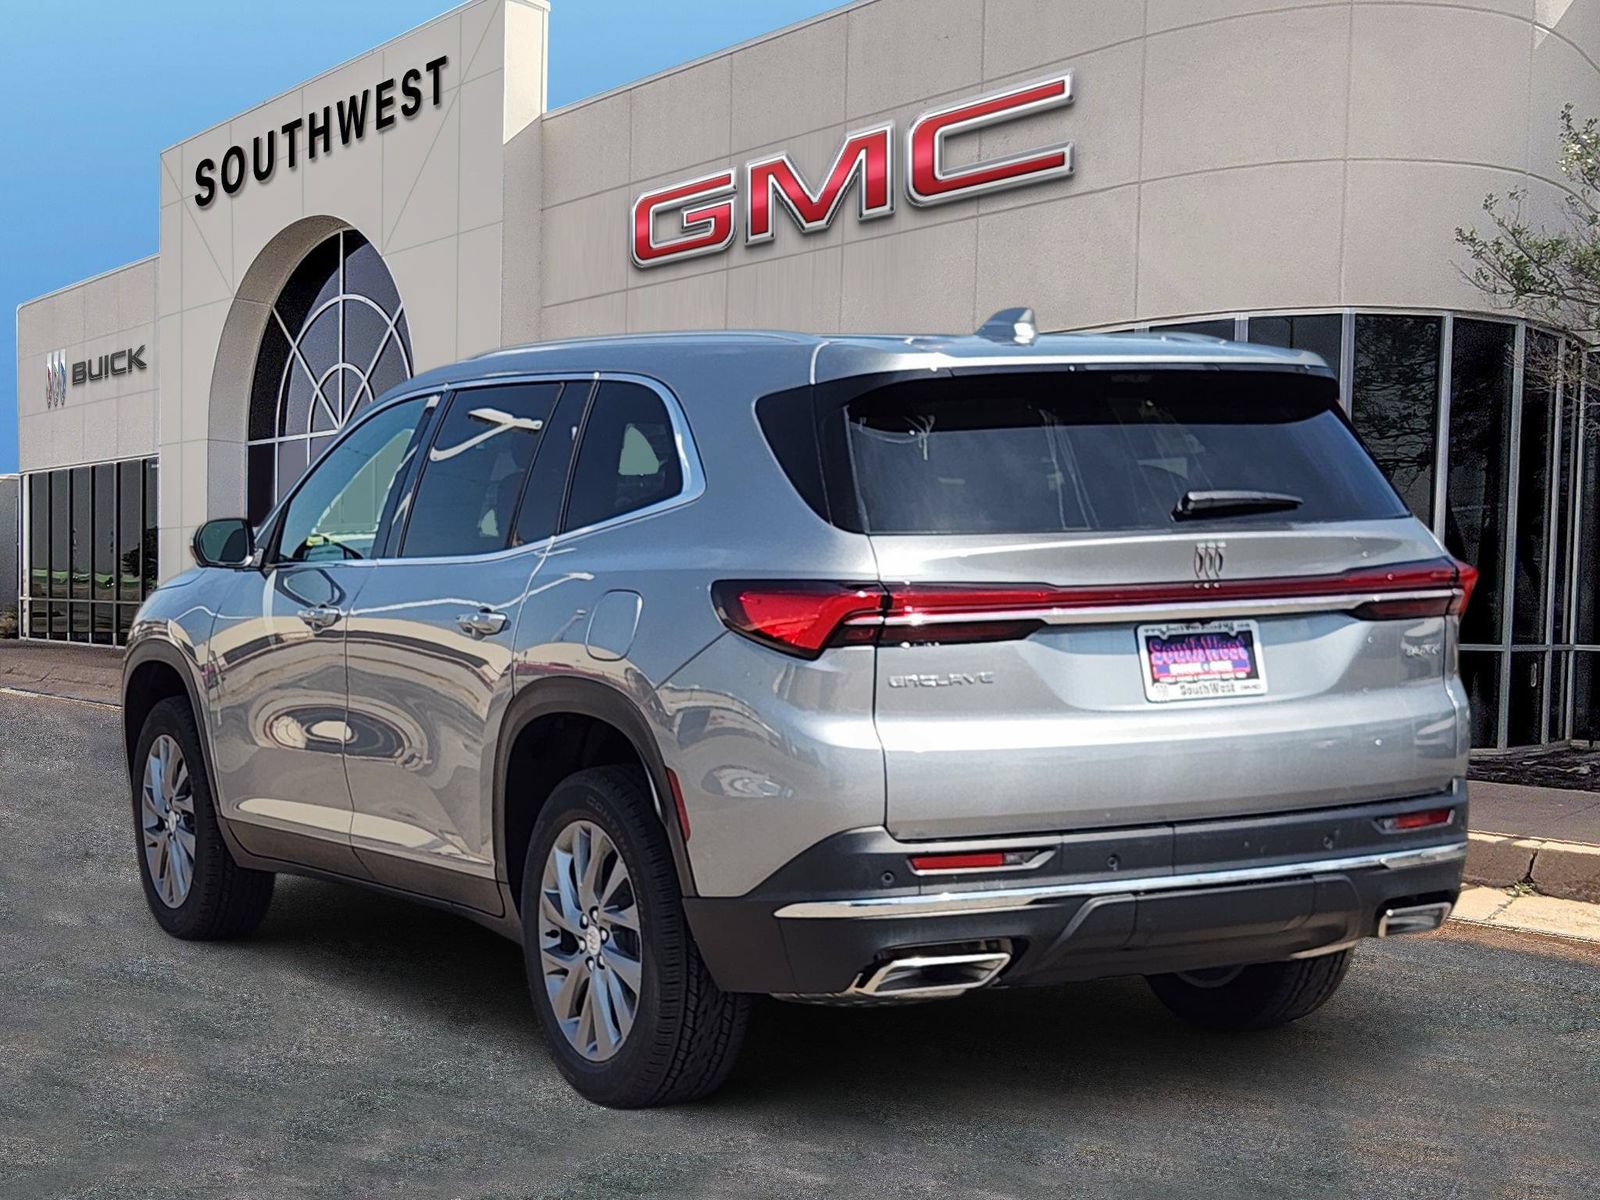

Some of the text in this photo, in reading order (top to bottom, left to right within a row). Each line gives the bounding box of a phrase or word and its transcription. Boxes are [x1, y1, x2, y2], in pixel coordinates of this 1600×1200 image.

[194, 55, 449, 208] SOUTHWEST
[630, 67, 1076, 269] GMC
[72, 344, 147, 385] BUICK
